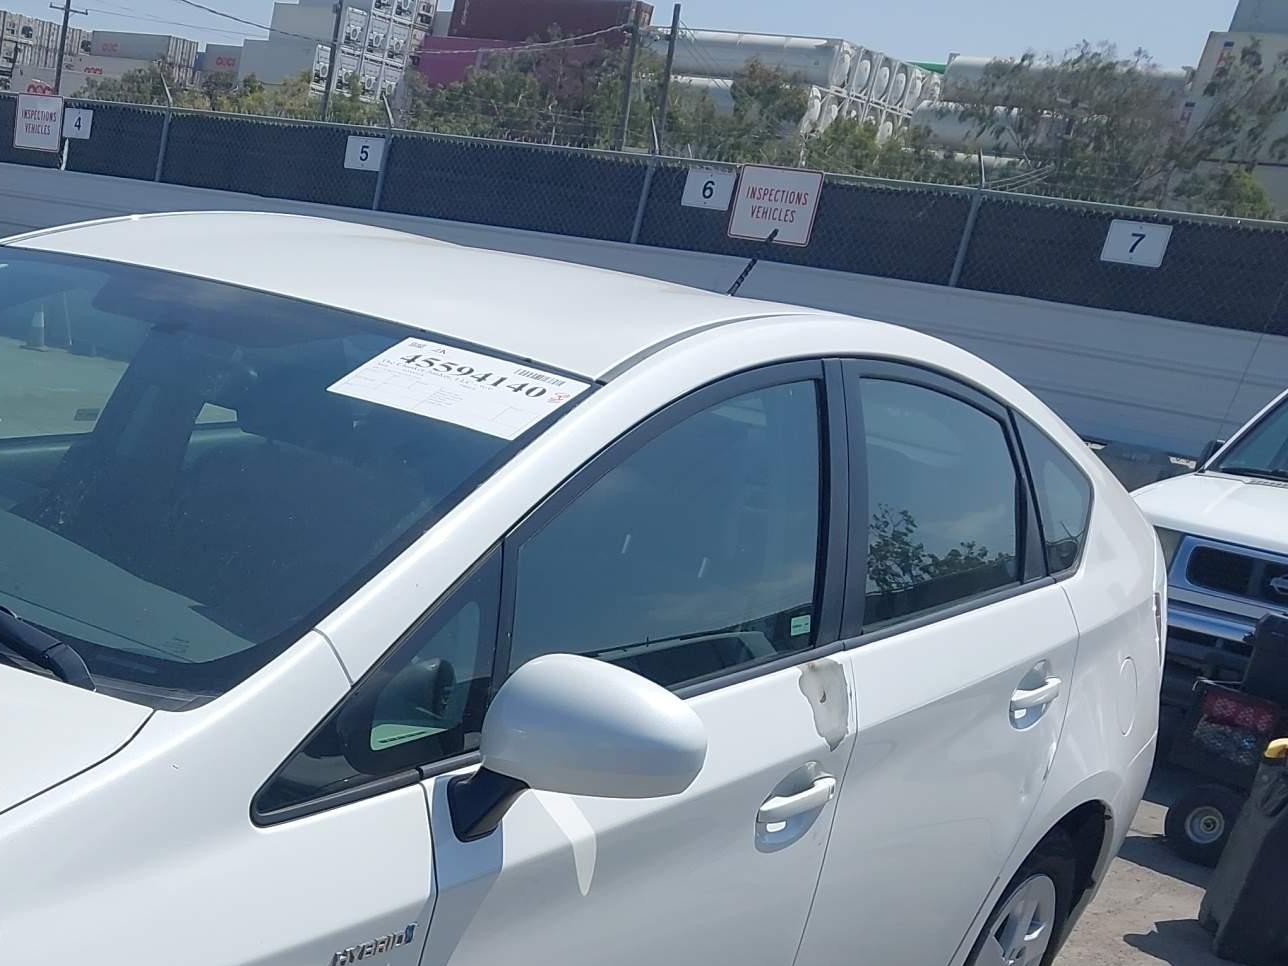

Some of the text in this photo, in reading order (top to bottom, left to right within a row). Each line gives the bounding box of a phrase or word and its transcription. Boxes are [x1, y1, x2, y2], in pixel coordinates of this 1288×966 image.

[22, 109, 57, 122] INSPECTIONS
[74, 116, 82, 131] 4
[25, 123, 51, 135] VEHICLES
[359, 145, 369, 161] 5
[702, 180, 715, 199] 6
[746, 185, 809, 206] INSPECTIONS
[750, 205, 796, 223] VEHICLES
[1129, 233, 1146, 253] 7
[399, 354, 547, 398] 45594140
